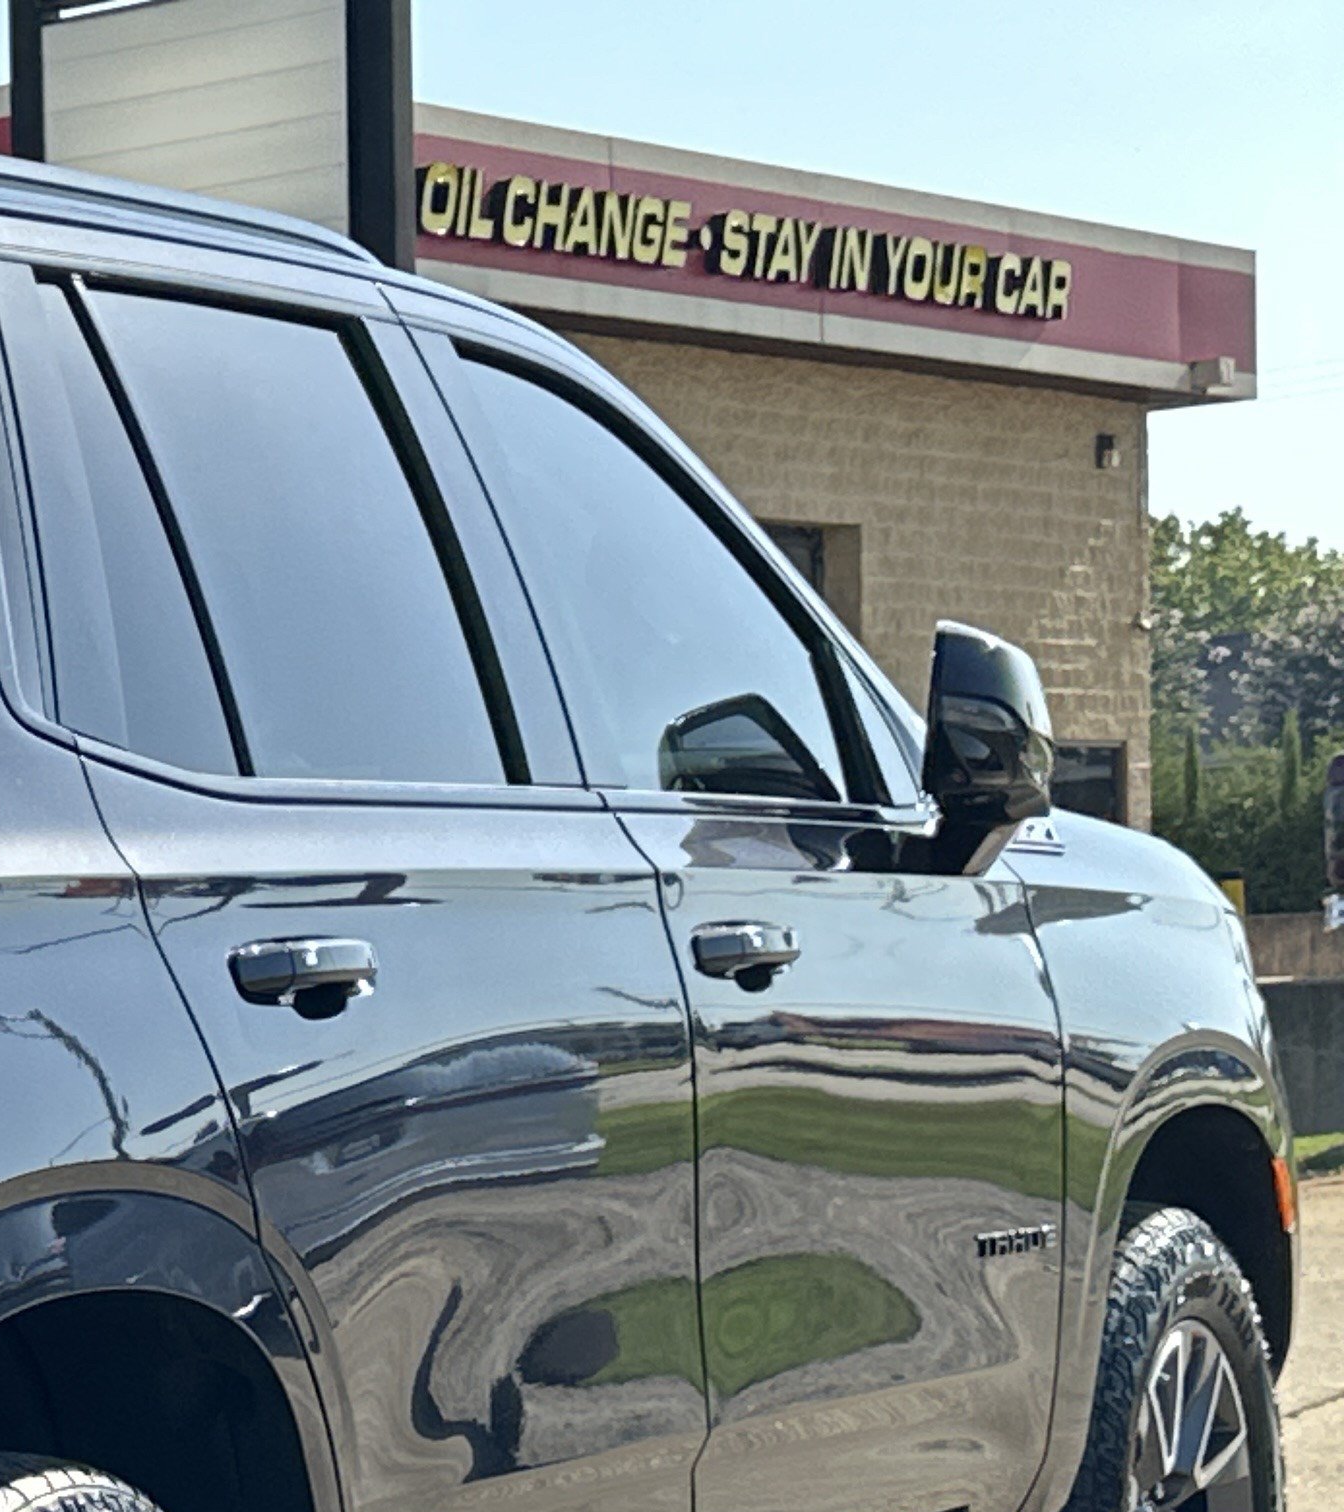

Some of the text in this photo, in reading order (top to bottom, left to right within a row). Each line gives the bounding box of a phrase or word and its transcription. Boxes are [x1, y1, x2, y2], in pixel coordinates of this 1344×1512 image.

[419, 161, 1073, 320] OIL CHANGE STAY IN YOUR CAR
[973, 1223, 1058, 1257] TAHOE
